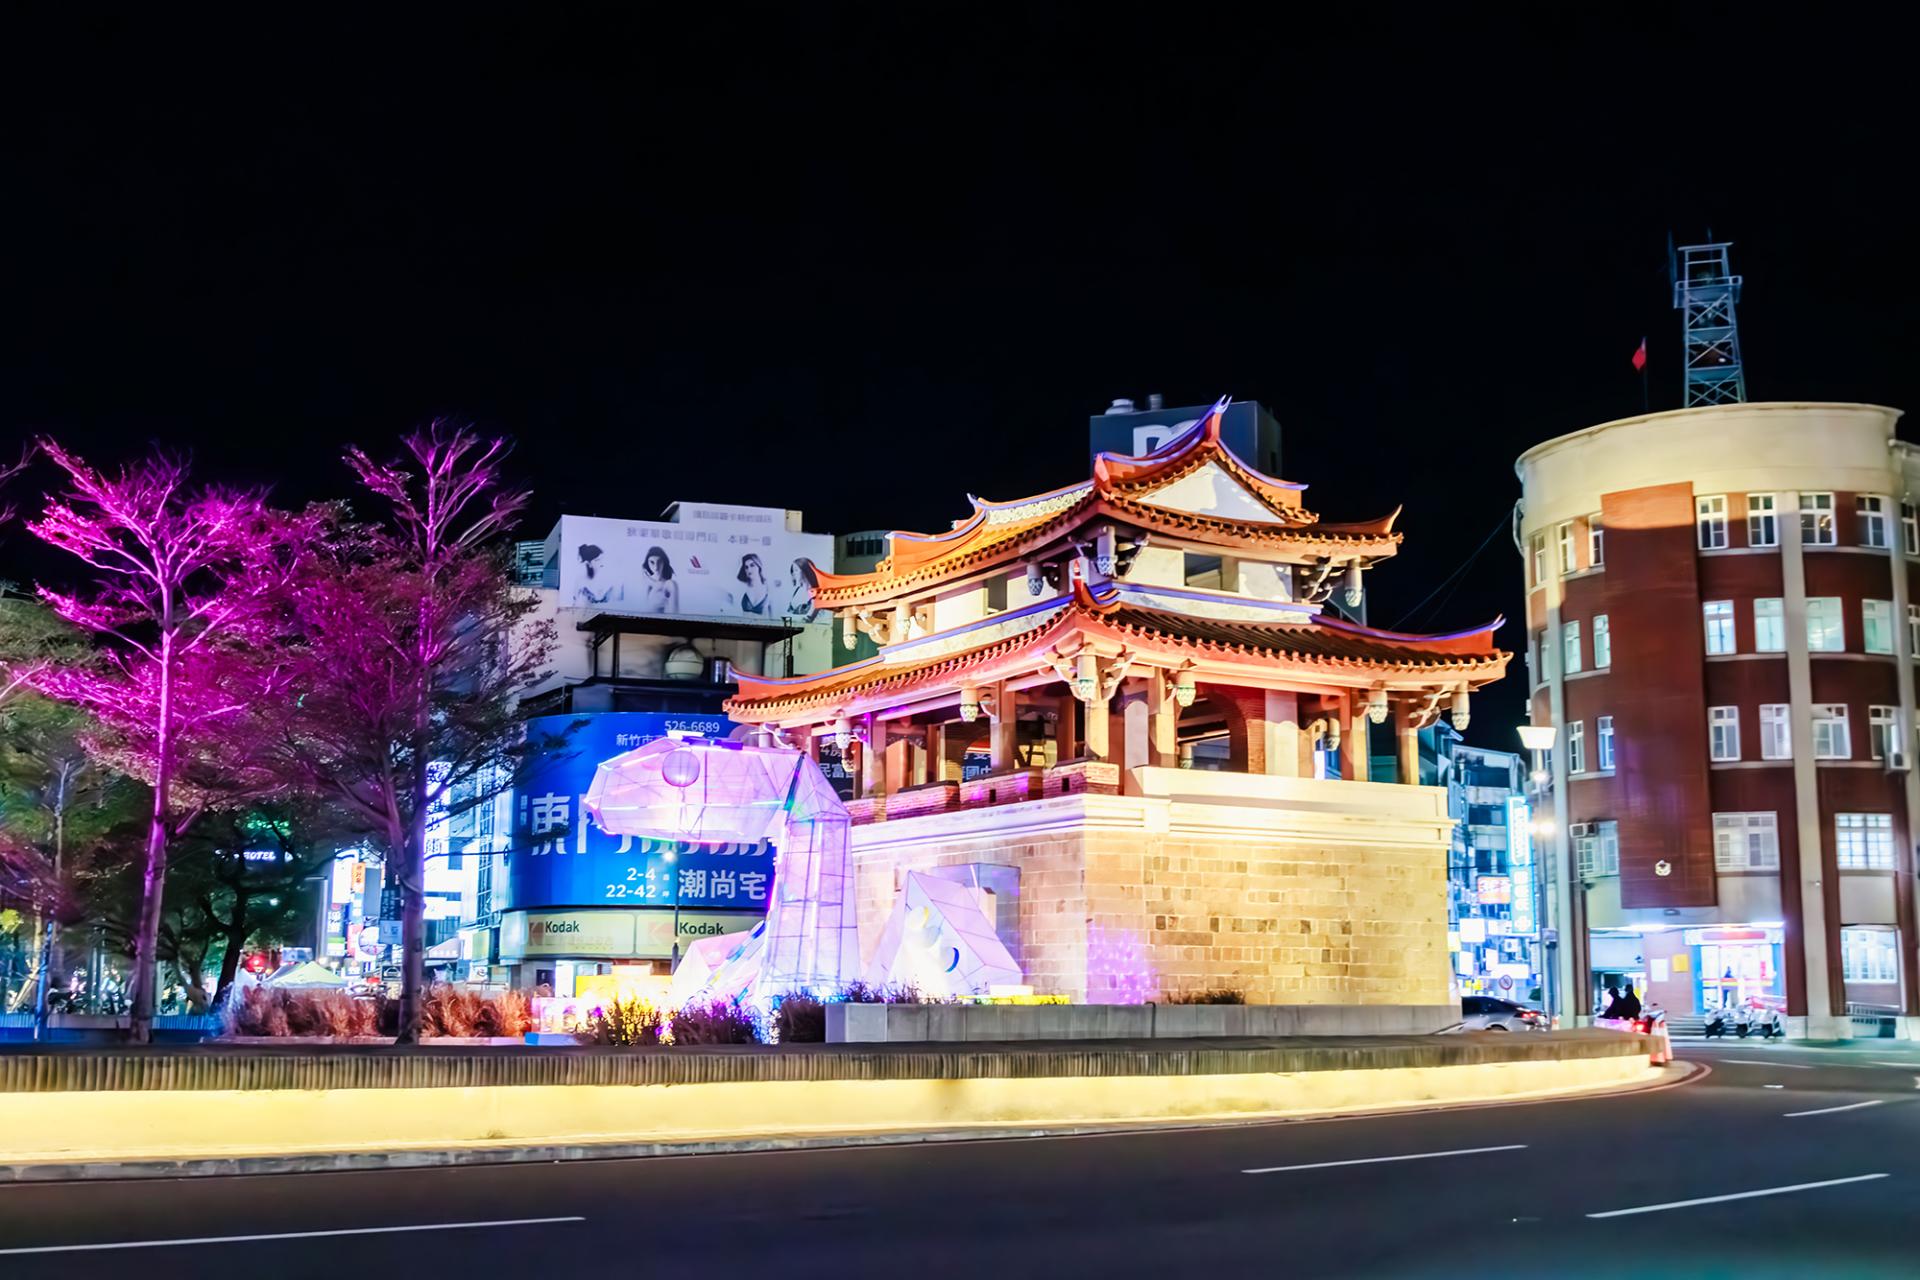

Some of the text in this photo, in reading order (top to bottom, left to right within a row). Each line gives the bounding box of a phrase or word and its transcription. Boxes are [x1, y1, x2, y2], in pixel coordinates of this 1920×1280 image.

[664, 720, 720, 733] 526-6689
[627, 867, 656, 881] 2-4
[678, 868, 767, 900] 潮尚宅
[605, 884, 657, 898] 22-42
[545, 921, 580, 933] Kodak
[679, 922, 724, 935] Kodak
